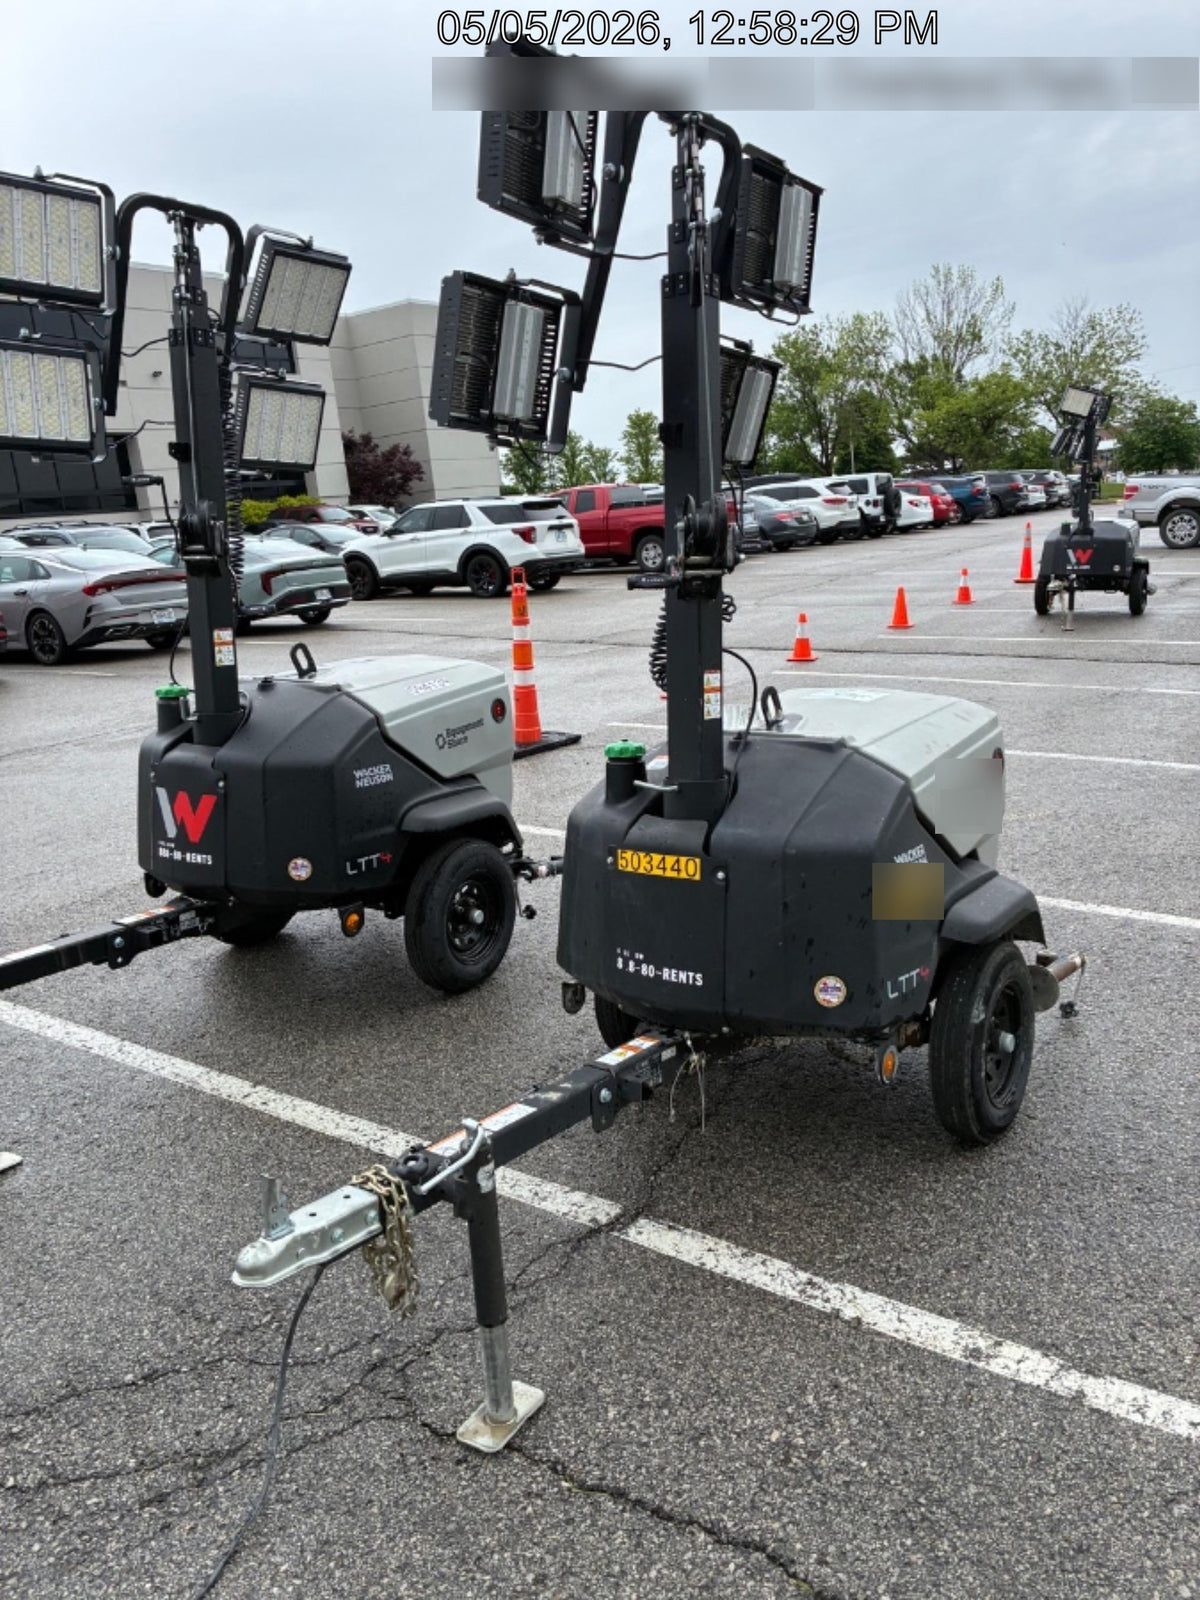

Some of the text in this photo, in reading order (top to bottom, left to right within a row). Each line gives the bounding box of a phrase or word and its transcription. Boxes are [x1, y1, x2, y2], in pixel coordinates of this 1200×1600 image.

[353, 764, 392, 779] WACKER
[355, 773, 394, 788] NEUSON
[619, 850, 699, 878] 503440
